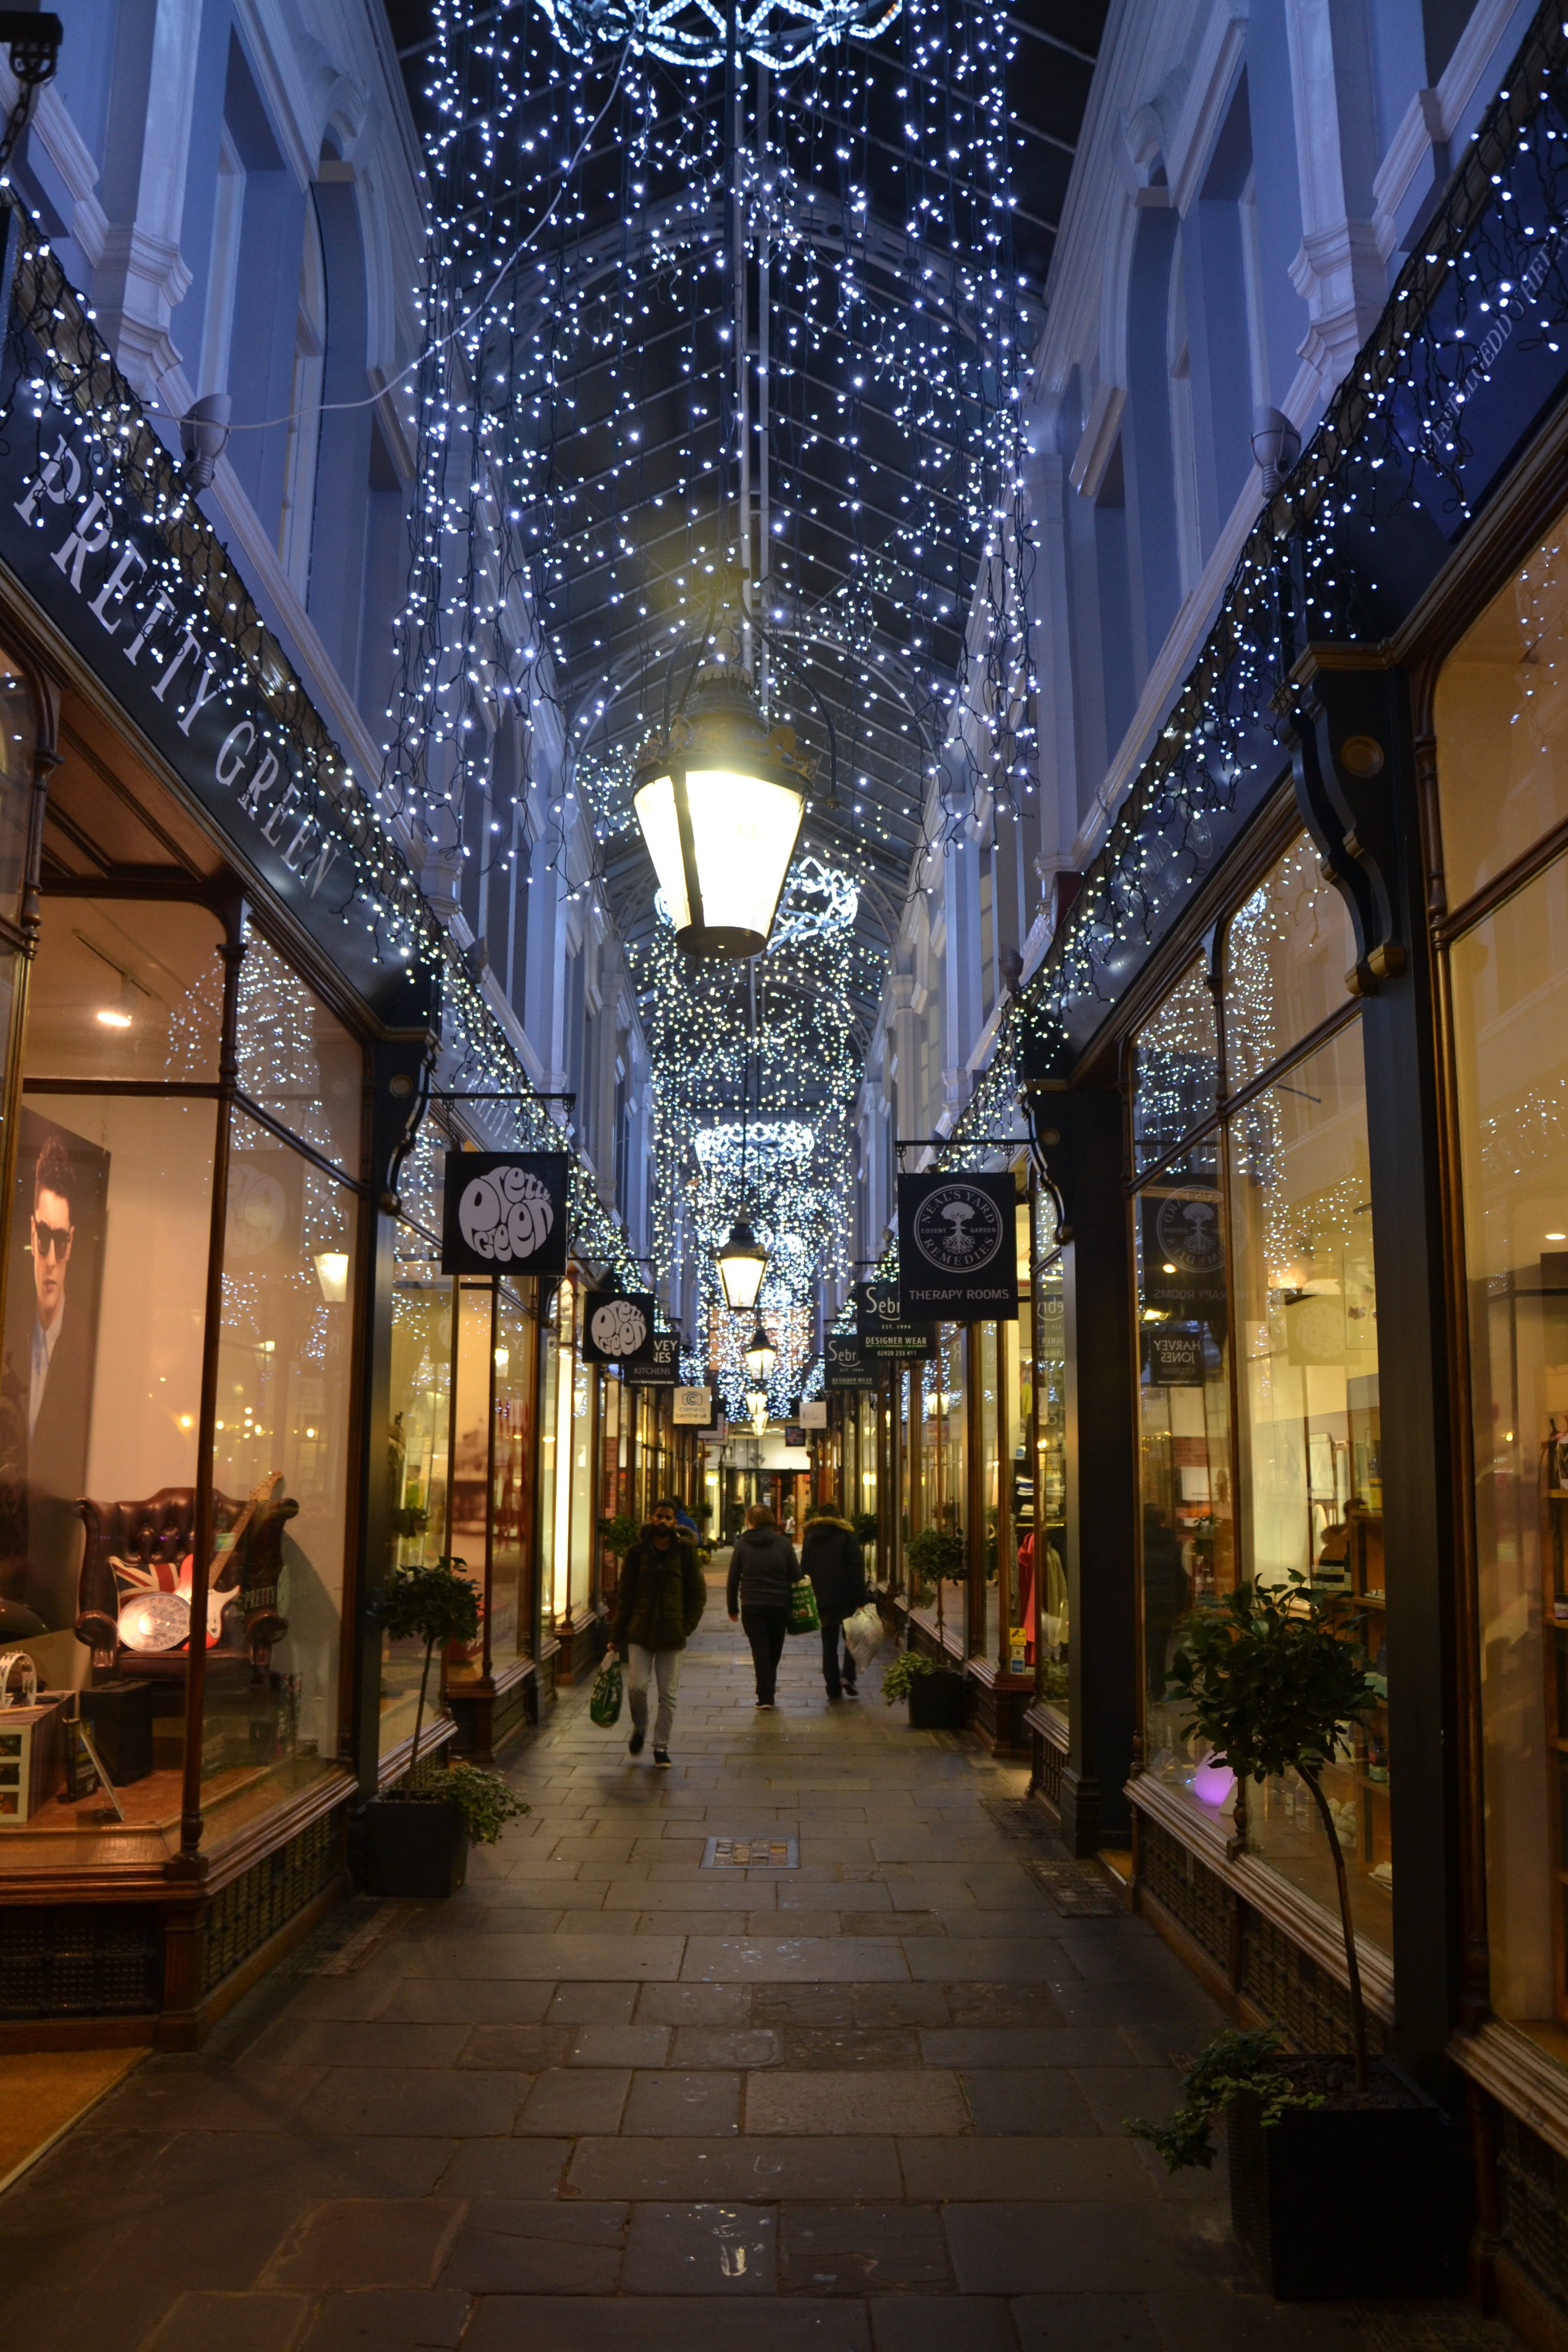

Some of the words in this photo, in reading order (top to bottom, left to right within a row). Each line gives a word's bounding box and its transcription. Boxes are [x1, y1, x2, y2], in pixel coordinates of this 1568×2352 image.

[13, 434, 225, 738] PRETTY
[215, 720, 340, 898] GREEN
[921, 1190, 961, 1224] NEAL'S
[965, 1192, 995, 1223] YARD
[923, 1236, 994, 1266] REMEDIES
[909, 1289, 963, 1301] THERAPY
[966, 1289, 1010, 1300] ROOMS
[653, 1340, 678, 1351] VEY
[866, 1336, 903, 1344] DESIGNER
[905, 1336, 927, 1344] WEAR
[653, 1352, 671, 1363] NES
[244, 1586, 276, 1609] PRETTY
